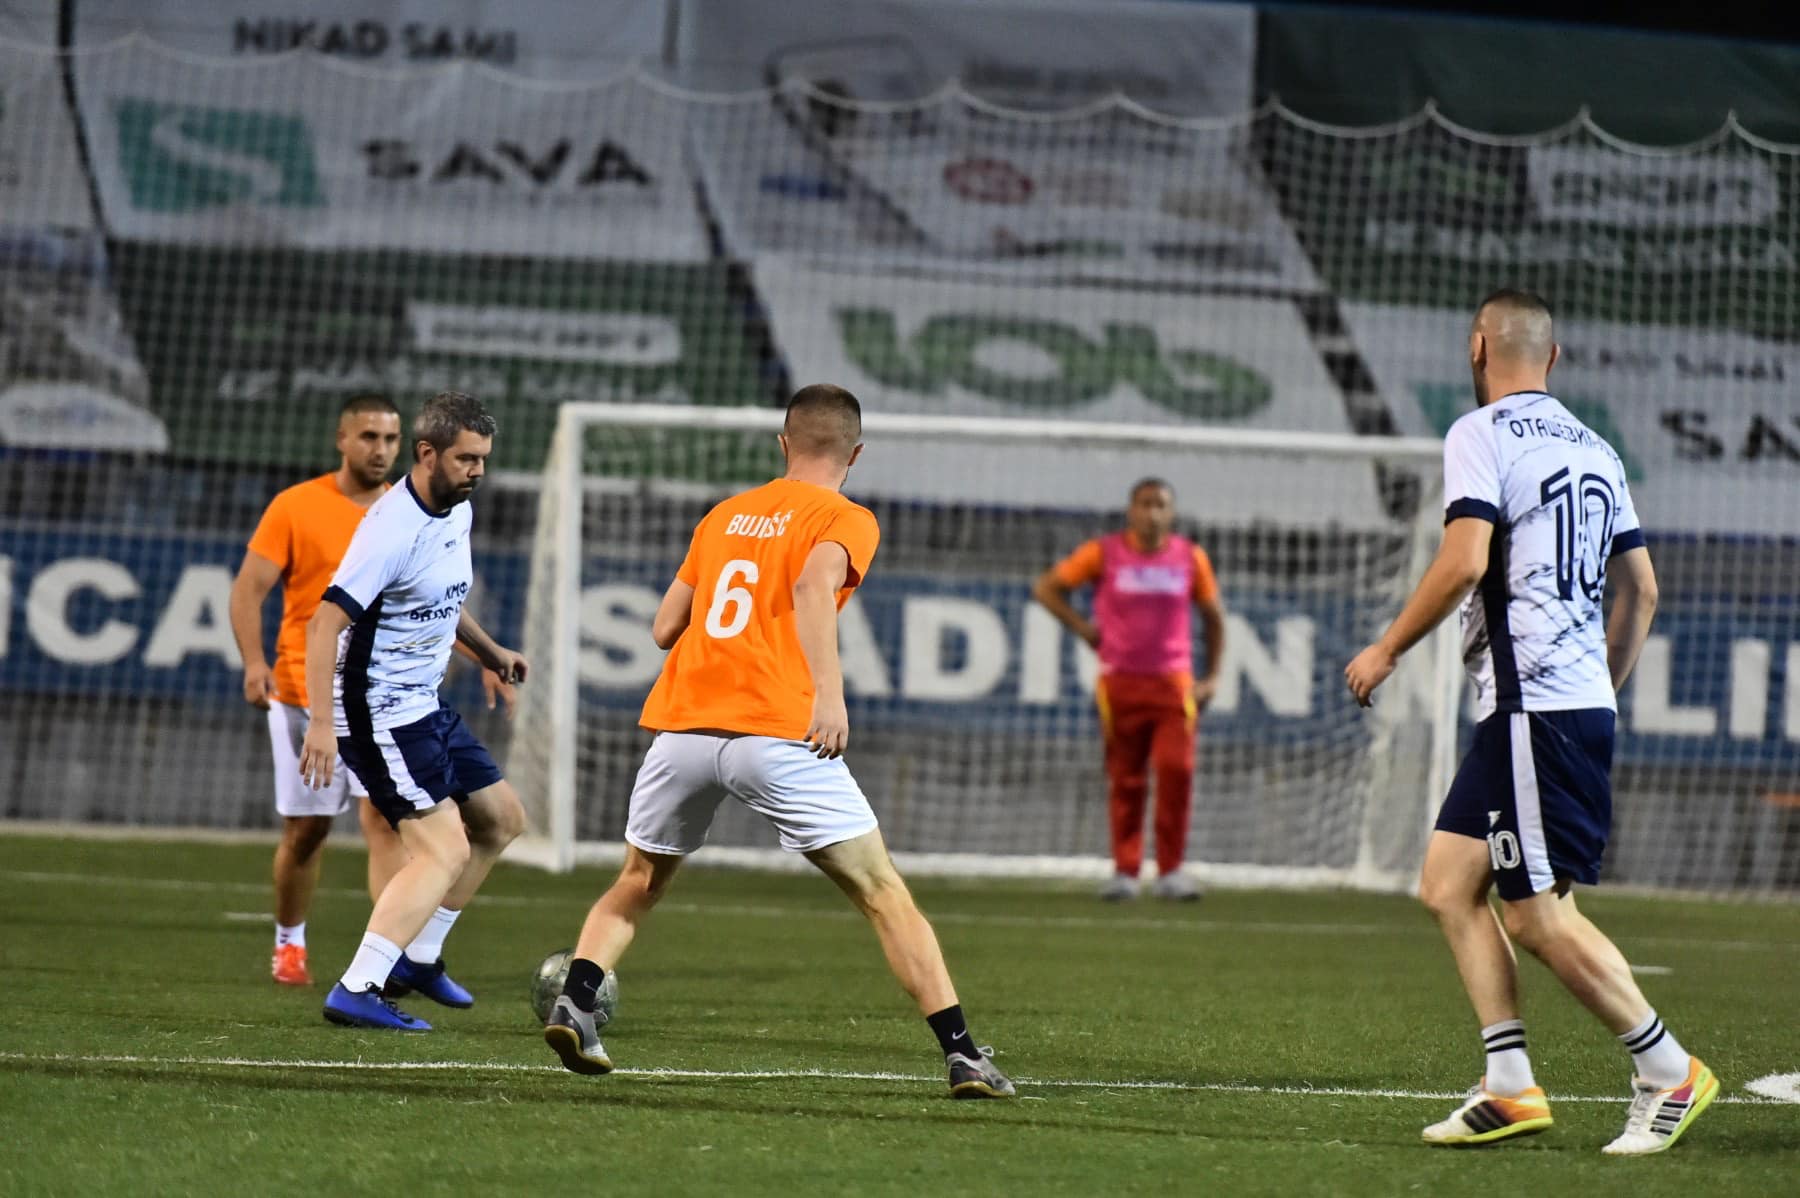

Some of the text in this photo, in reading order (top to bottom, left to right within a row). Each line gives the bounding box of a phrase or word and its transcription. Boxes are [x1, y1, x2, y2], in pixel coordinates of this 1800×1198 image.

[402, 23, 517, 64] SAMI
[363, 136, 655, 186] SAVA
[1658, 408, 1800, 463] SA
[1540, 465, 1616, 604] 10
[705, 559, 759, 639] 6
[1486, 830, 1521, 870] 10
